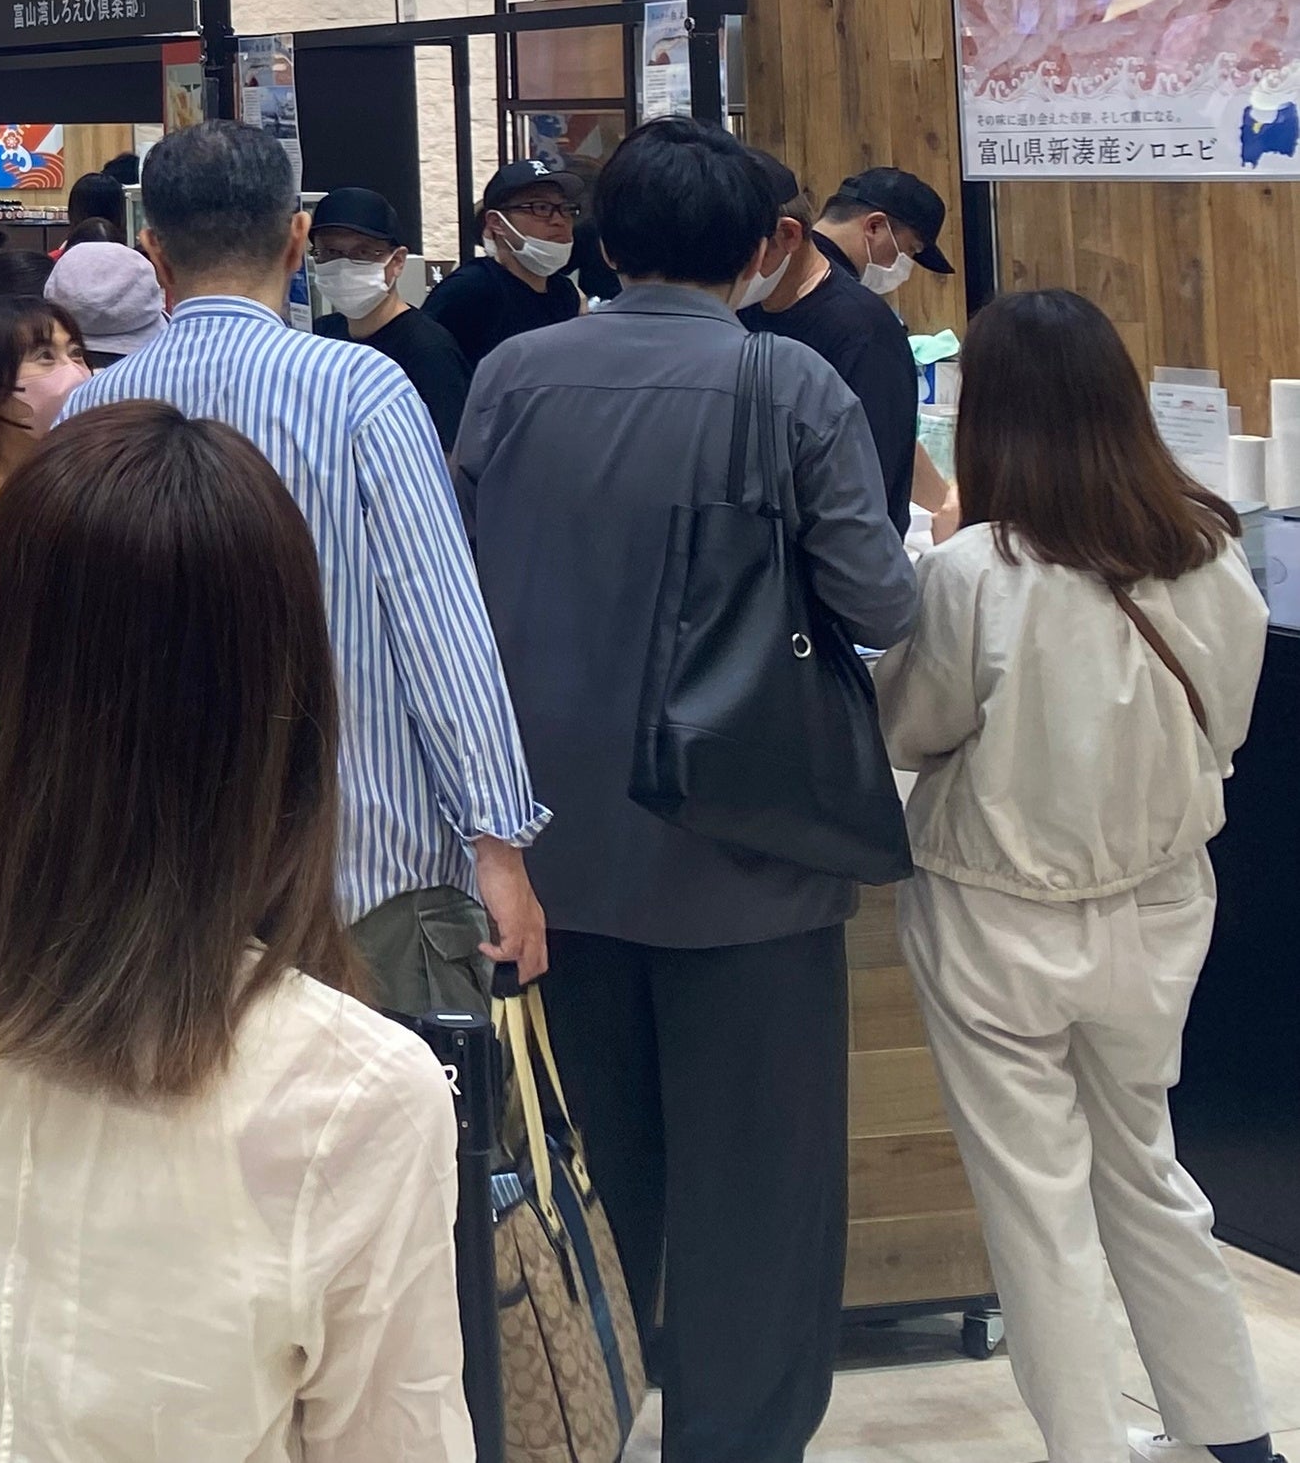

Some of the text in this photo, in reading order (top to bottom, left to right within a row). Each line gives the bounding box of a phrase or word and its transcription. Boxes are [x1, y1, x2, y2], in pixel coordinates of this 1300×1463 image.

[977, 136, 1218, 166] 富山県新湊産シロエビ
